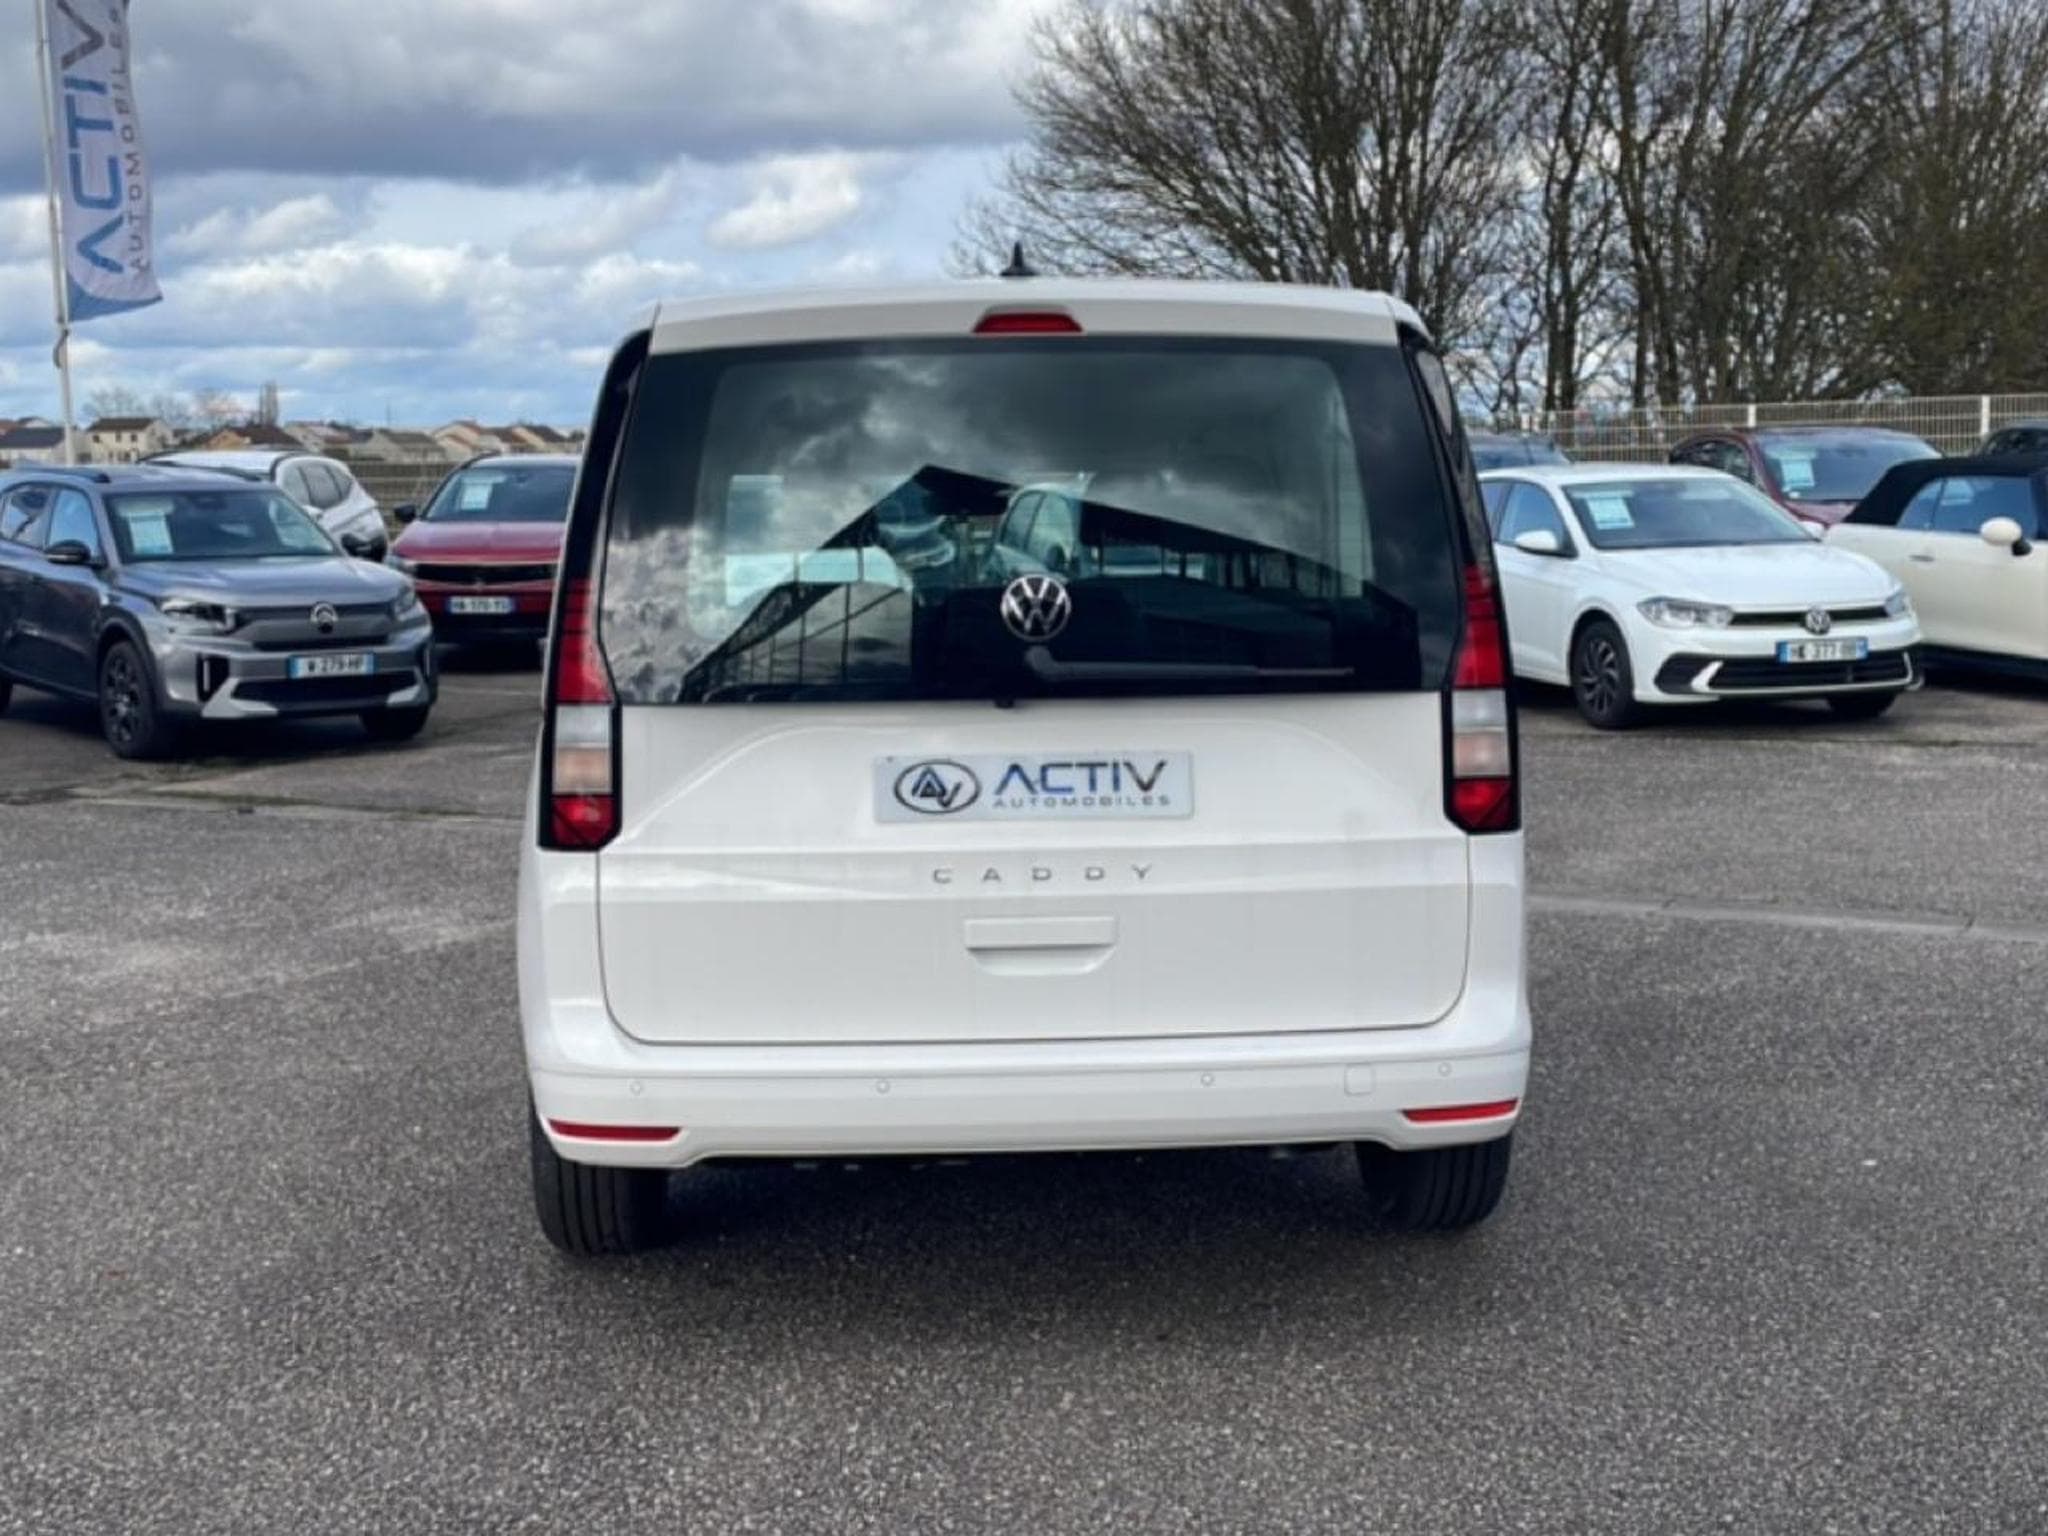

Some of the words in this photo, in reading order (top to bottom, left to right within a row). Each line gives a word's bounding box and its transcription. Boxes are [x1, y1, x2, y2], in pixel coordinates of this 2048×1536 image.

[57, 0, 124, 274] ACTIV
[994, 760, 1167, 795] ACTIV
[992, 795, 1170, 808] AUTOMOBILES
[932, 864, 1152, 885] CADDY
